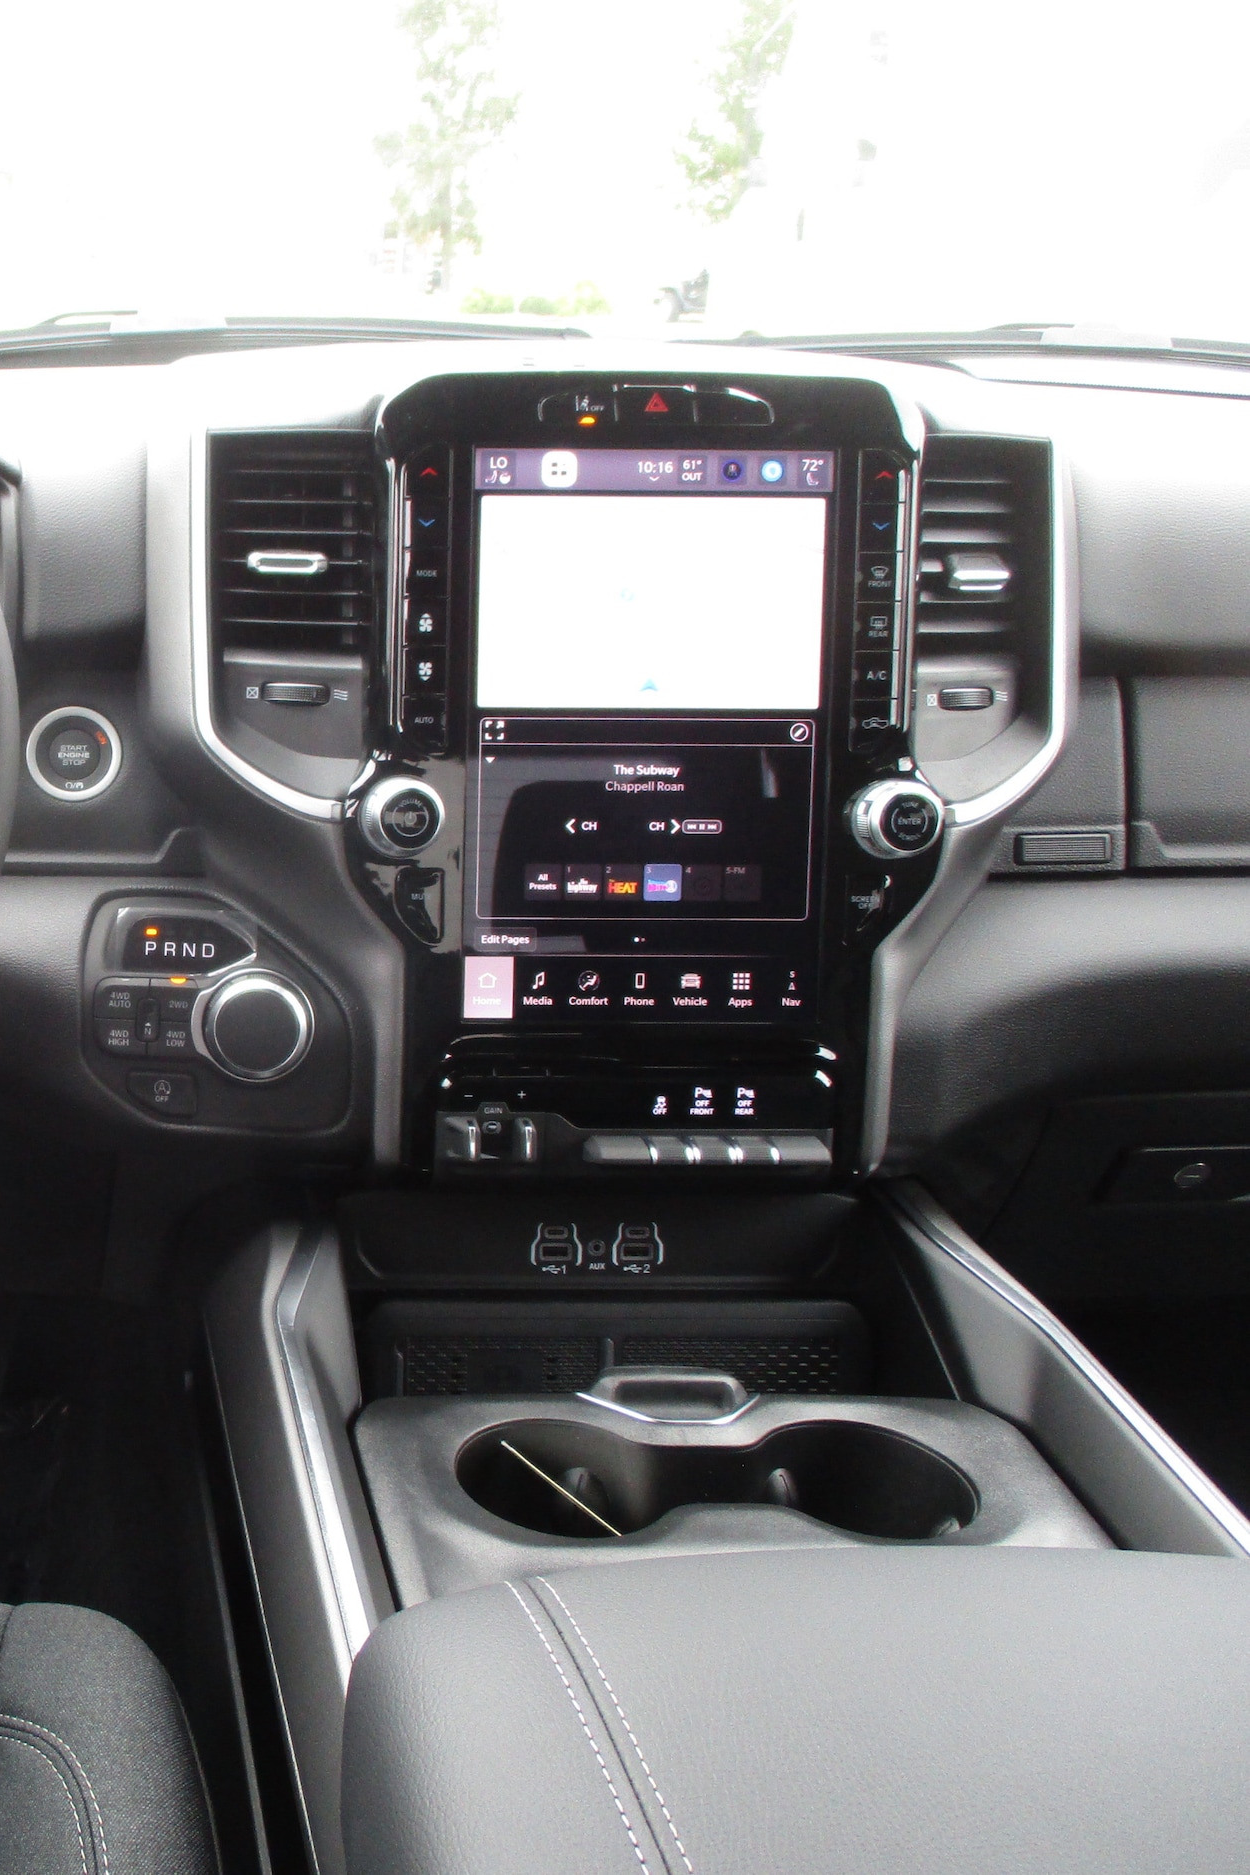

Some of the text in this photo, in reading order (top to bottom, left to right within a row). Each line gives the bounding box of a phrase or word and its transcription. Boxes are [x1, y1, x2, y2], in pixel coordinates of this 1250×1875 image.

[490, 457, 508, 468] LO
[638, 461, 673, 473] 10:16
[682, 460, 702, 470] 61°
[802, 459, 824, 472] 72°
[682, 472, 703, 481] OUT
[866, 671, 887, 681] A/C
[614, 765, 680, 777] The Subway
[605, 781, 684, 793] Chappell Roan
[581, 821, 664, 831] CH CH
[897, 817, 922, 825] ENTER
[725, 866, 745, 874] 5-FM
[538, 873, 549, 882] All
[529, 882, 557, 891] Presets
[567, 882, 598, 893] highway
[608, 882, 637, 893] HEAT
[481, 934, 530, 947] Edit Pages
[145, 942, 215, 958] P R N D
[109, 1000, 131, 1008] AUTO
[169, 1000, 188, 1008] 2WD
[473, 996, 501, 1006] Home
[523, 996, 552, 1006] Media
[569, 996, 608, 1006] Comfort
[624, 996, 654, 1006] Phone
[673, 996, 707, 1006] Vehicle
[728, 997, 752, 1008] Apps
[782, 997, 801, 1006] Nav
[110, 1030, 129, 1038] 4WD
[108, 1038, 129, 1046] HIGH
[166, 1039, 185, 1047] LOW
[589, 1262, 605, 1270] AUX
[643, 1264, 650, 1273] 2
